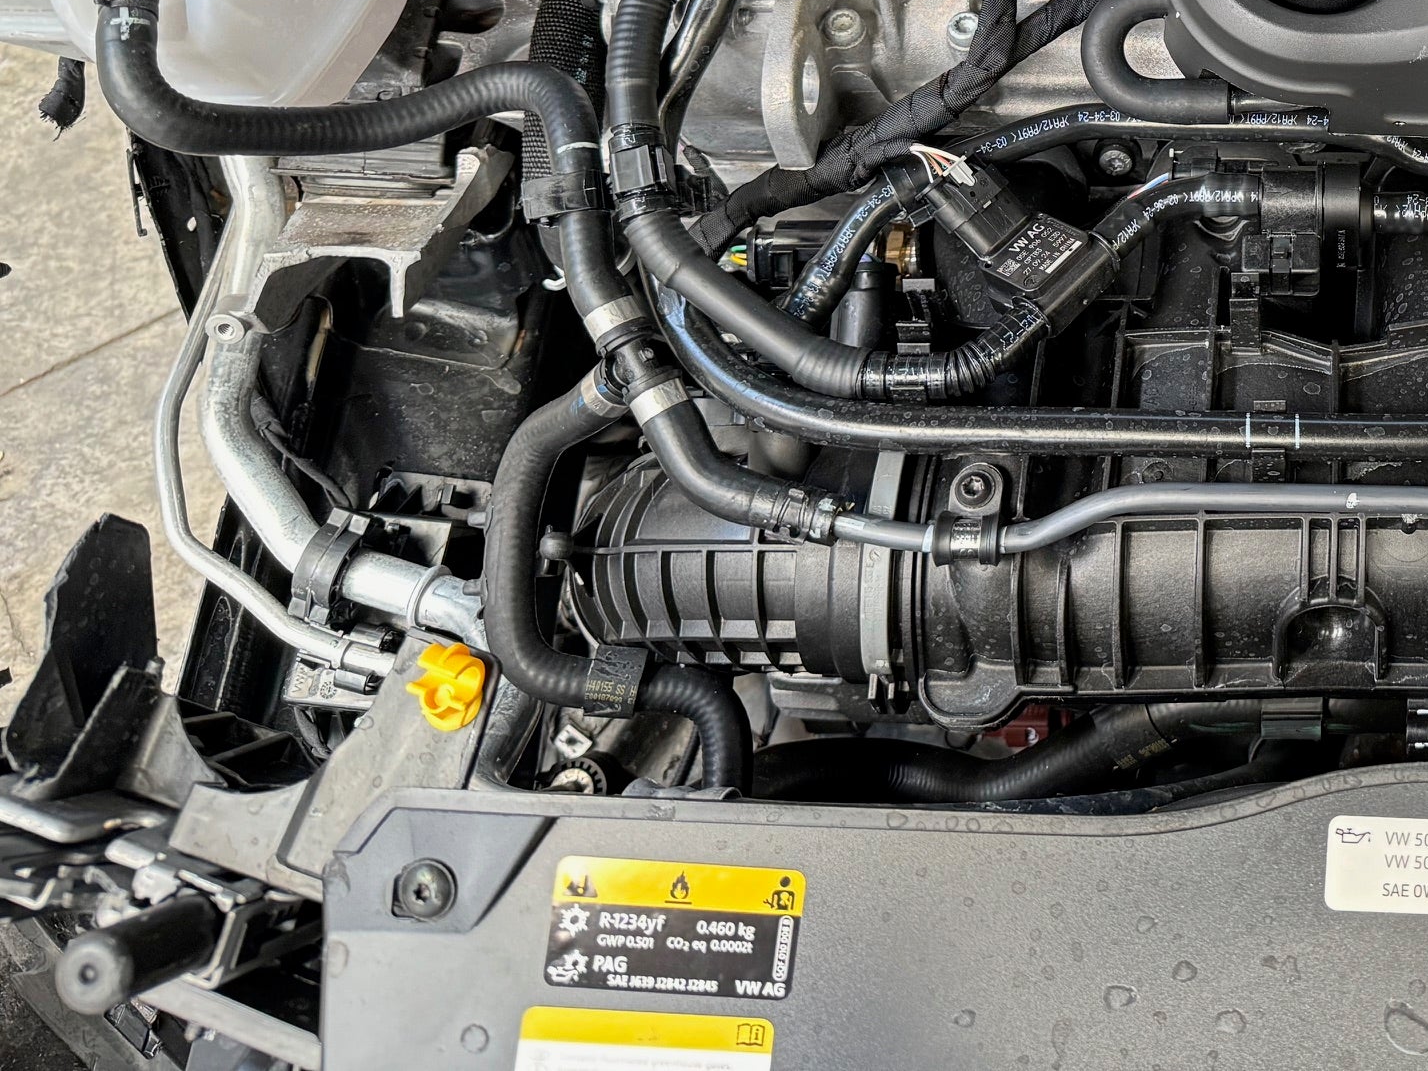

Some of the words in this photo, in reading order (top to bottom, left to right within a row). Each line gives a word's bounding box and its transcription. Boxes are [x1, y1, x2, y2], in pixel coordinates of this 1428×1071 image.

[1077, 110, 1121, 123] 03-34-24
[1009, 236, 1029, 252] VW
[1027, 223, 1045, 239] AG
[1028, 239, 1042, 249] 906
[1060, 237, 1076, 252] CHINA
[1385, 831, 1410, 847] VW
[1384, 854, 1410, 869] VW
[1382, 882, 1409, 898] SAE
[599, 912, 666, 935] R-1234yf
[696, 920, 735, 937] 0.460
[736, 922, 756, 941] kg
[596, 935, 624, 947] GWP
[626, 936, 655, 950] 0.501
[691, 939, 706, 953] eq
[591, 954, 628, 974] PAG
[606, 974, 628, 988] SAE
[628, 975, 654, 989] J639
[655, 976, 687, 991] J2842
[687, 978, 719, 993] J2845
[735, 980, 762, 995] VW
[763, 981, 787, 999] AG
